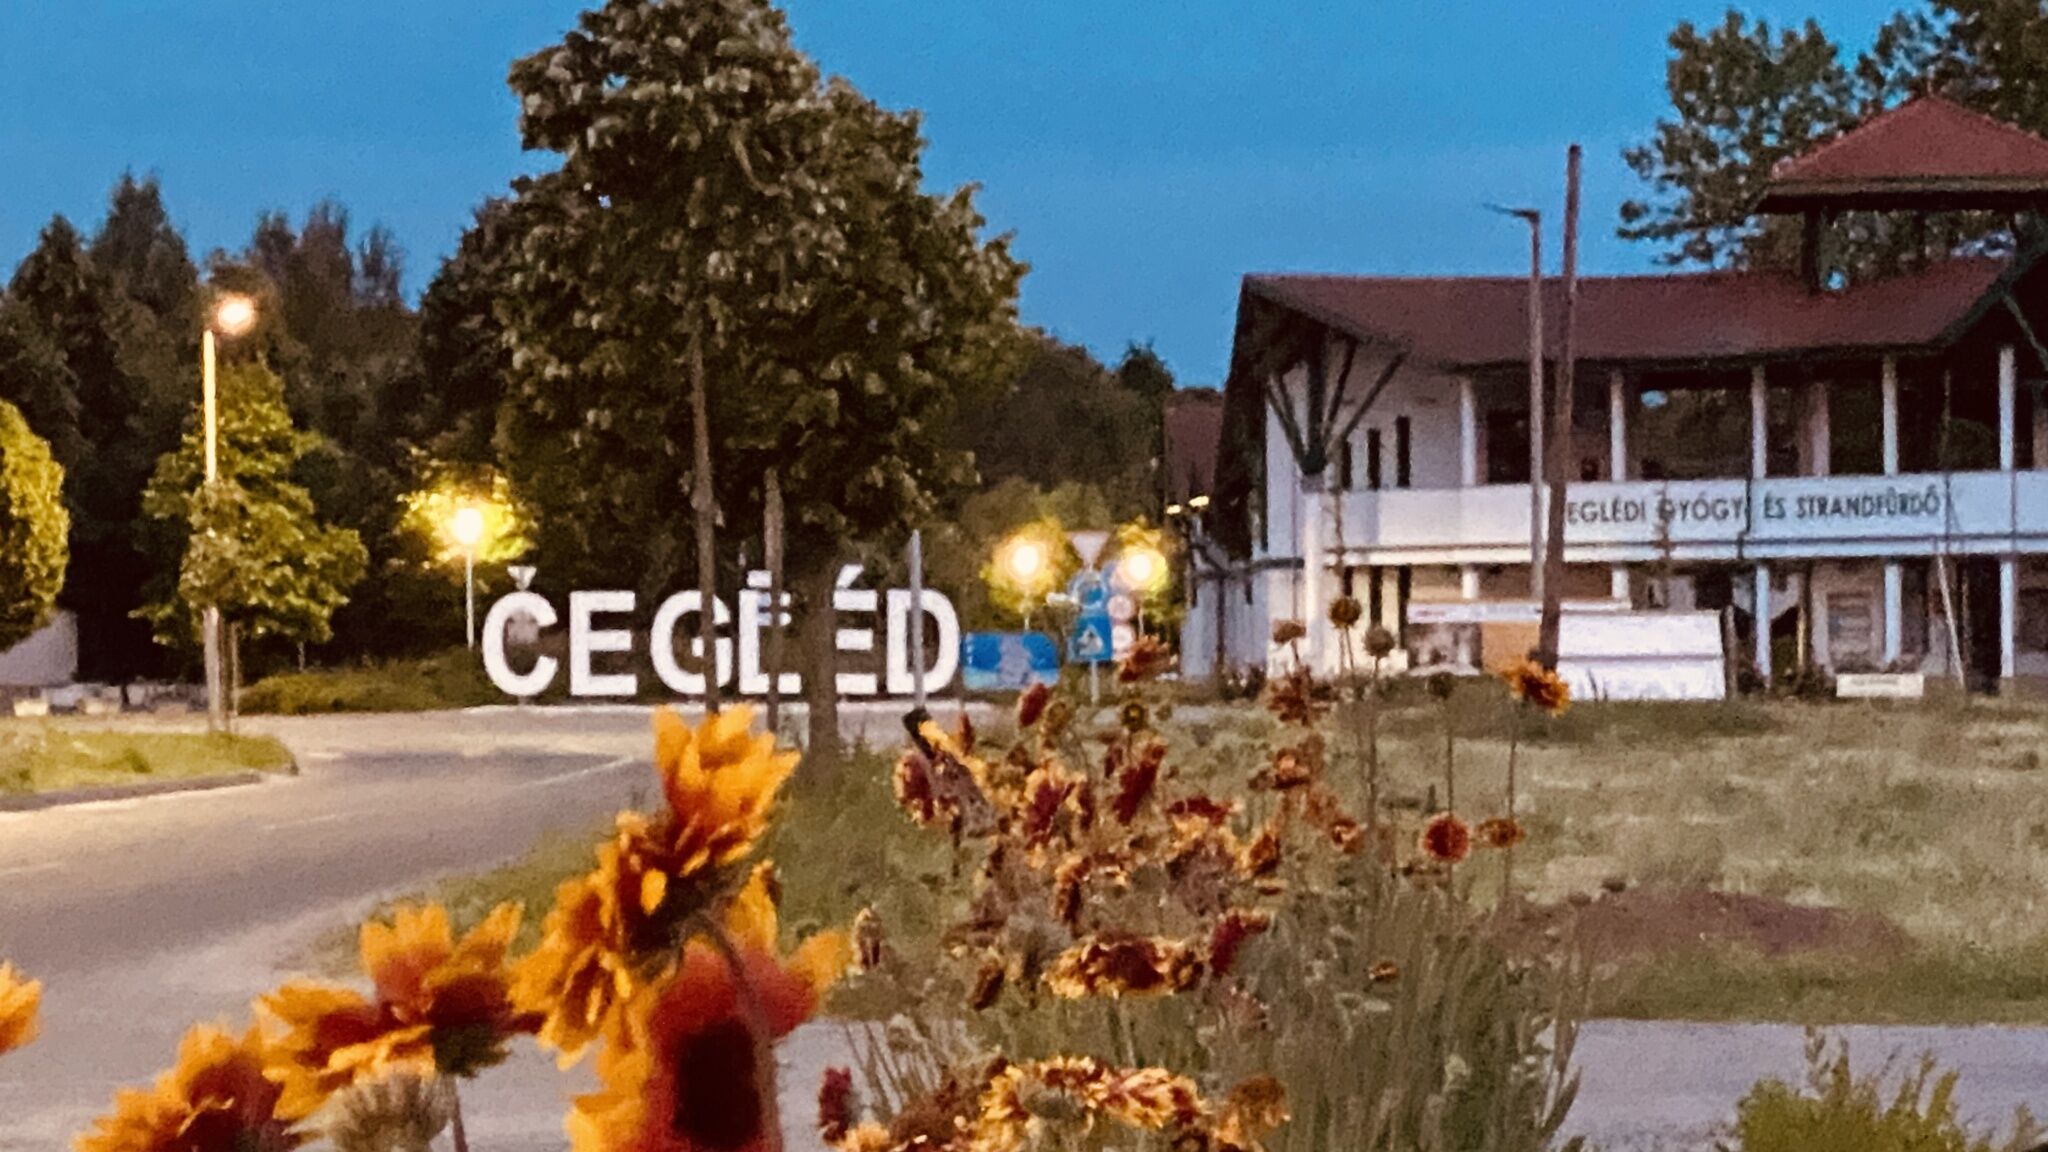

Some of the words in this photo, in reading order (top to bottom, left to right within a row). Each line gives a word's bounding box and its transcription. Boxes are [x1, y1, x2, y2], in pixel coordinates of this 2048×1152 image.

[1566, 496, 1646, 524] EGLÉDI
[1763, 490, 1787, 519] ÉS
[482, 564, 961, 696] CEGLÉD
